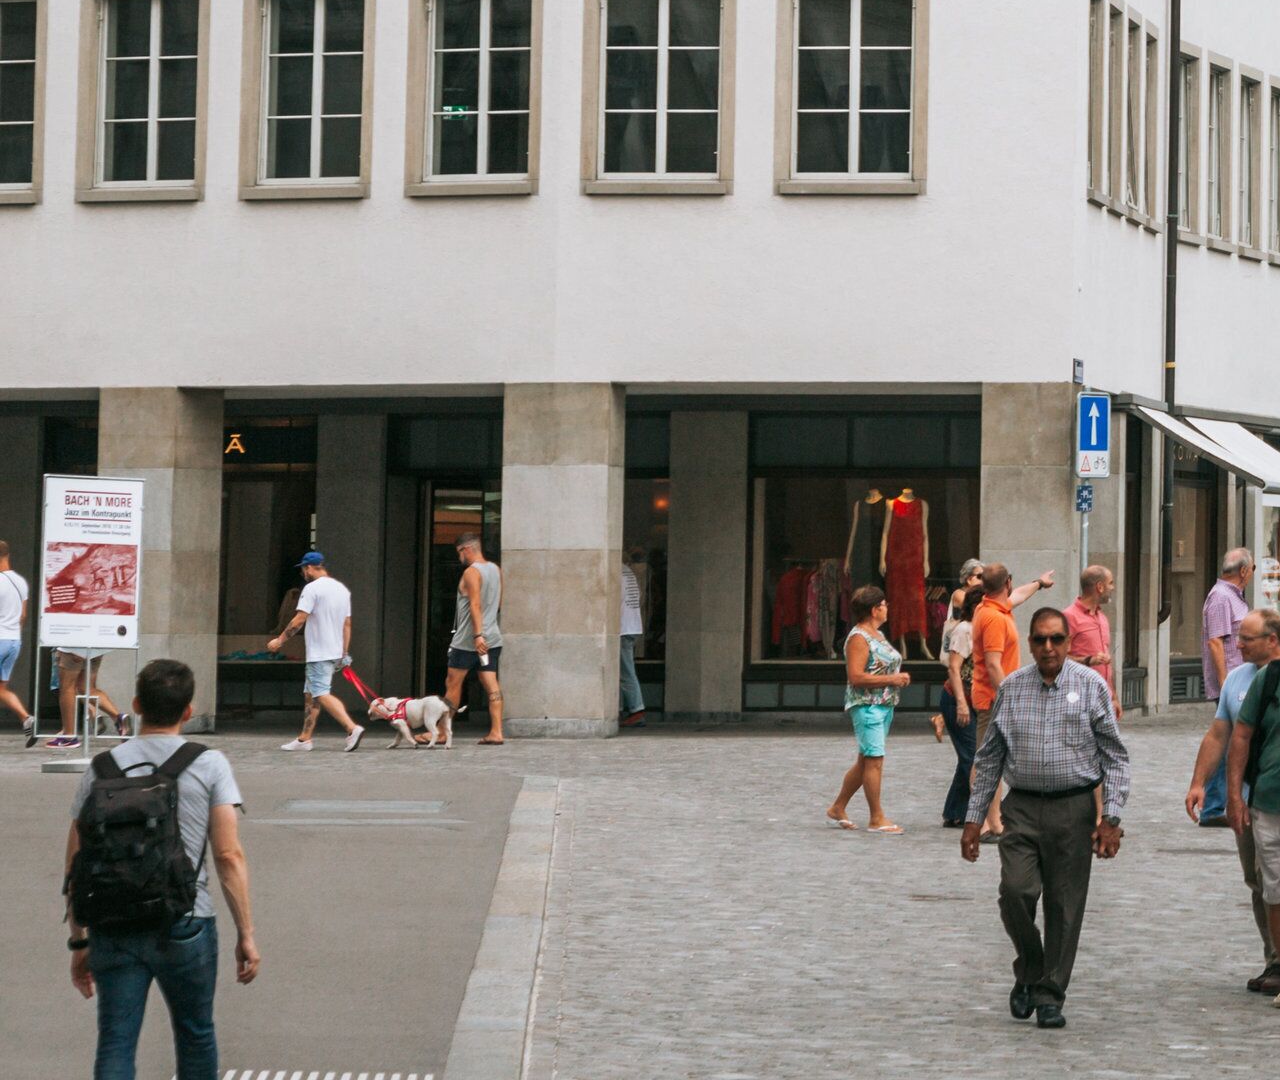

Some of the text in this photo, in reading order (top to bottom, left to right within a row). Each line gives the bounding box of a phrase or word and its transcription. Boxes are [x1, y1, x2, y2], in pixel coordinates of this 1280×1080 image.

[65, 495, 90, 506] BACH
[105, 497, 132, 507] MORE
[64, 508, 79, 516] Jazz
[91, 509, 132, 519] Kontrapunkt
